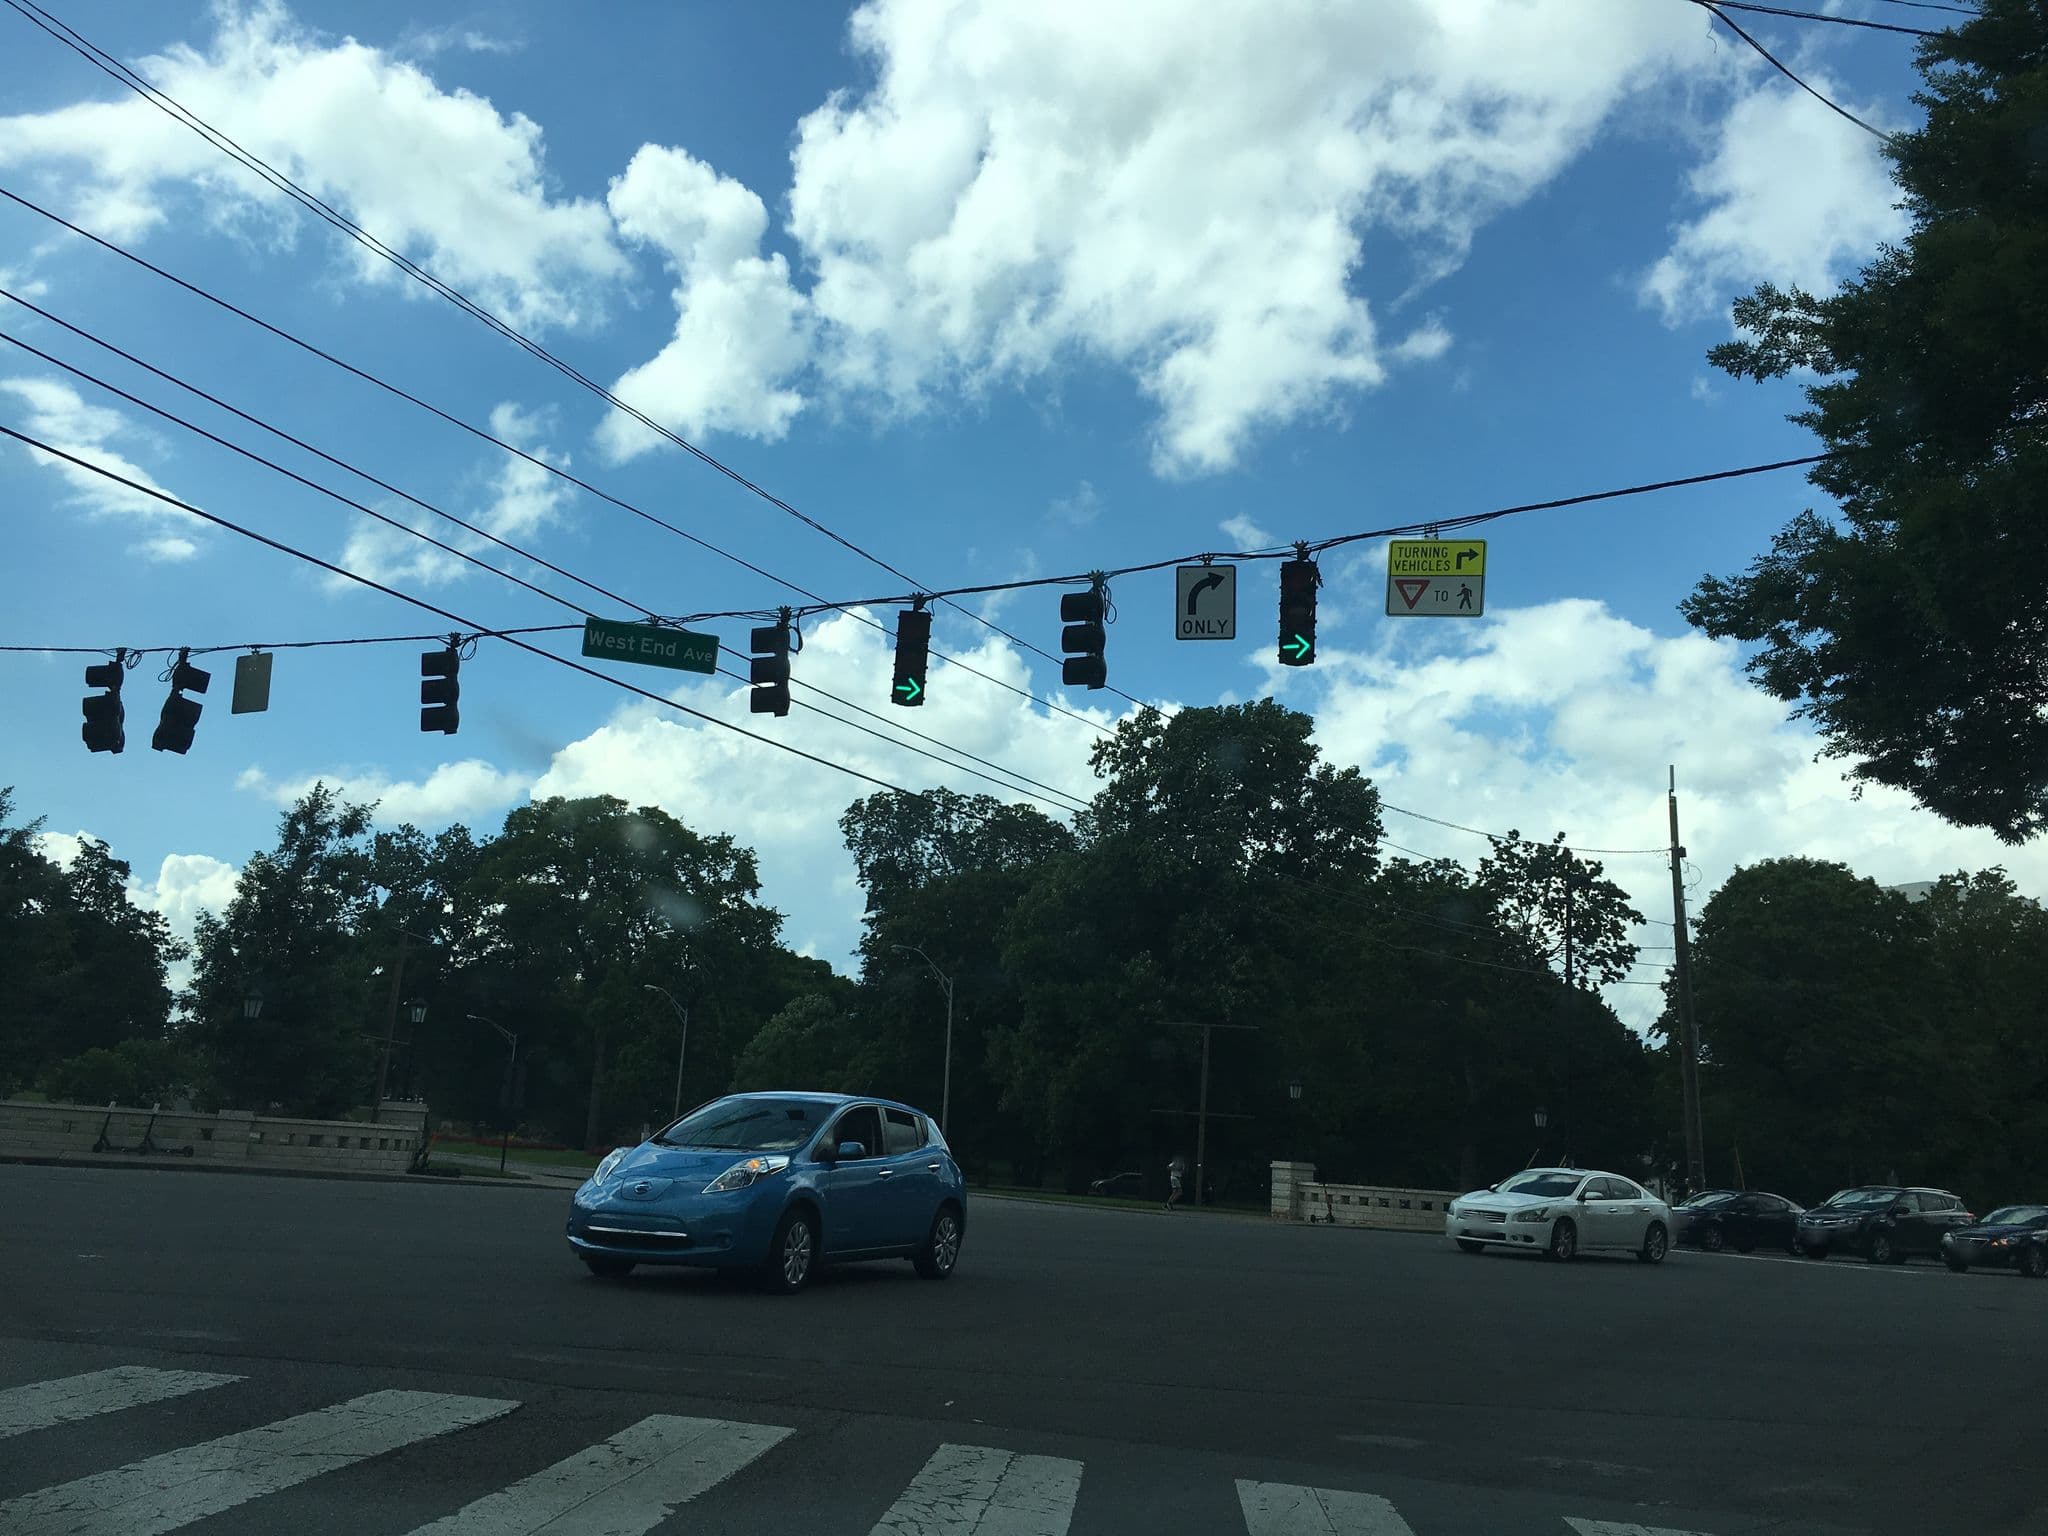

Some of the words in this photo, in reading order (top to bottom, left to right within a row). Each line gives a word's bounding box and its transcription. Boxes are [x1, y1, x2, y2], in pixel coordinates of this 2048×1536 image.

[1398, 547, 1448, 559] TURNING
[1394, 560, 1451, 572] VEHICLES
[1434, 590, 1449, 602] TO
[1183, 619, 1228, 634] ONLY
[588, 629, 636, 651] West
[640, 637, 677, 657] End
[683, 648, 713, 662] Ave
